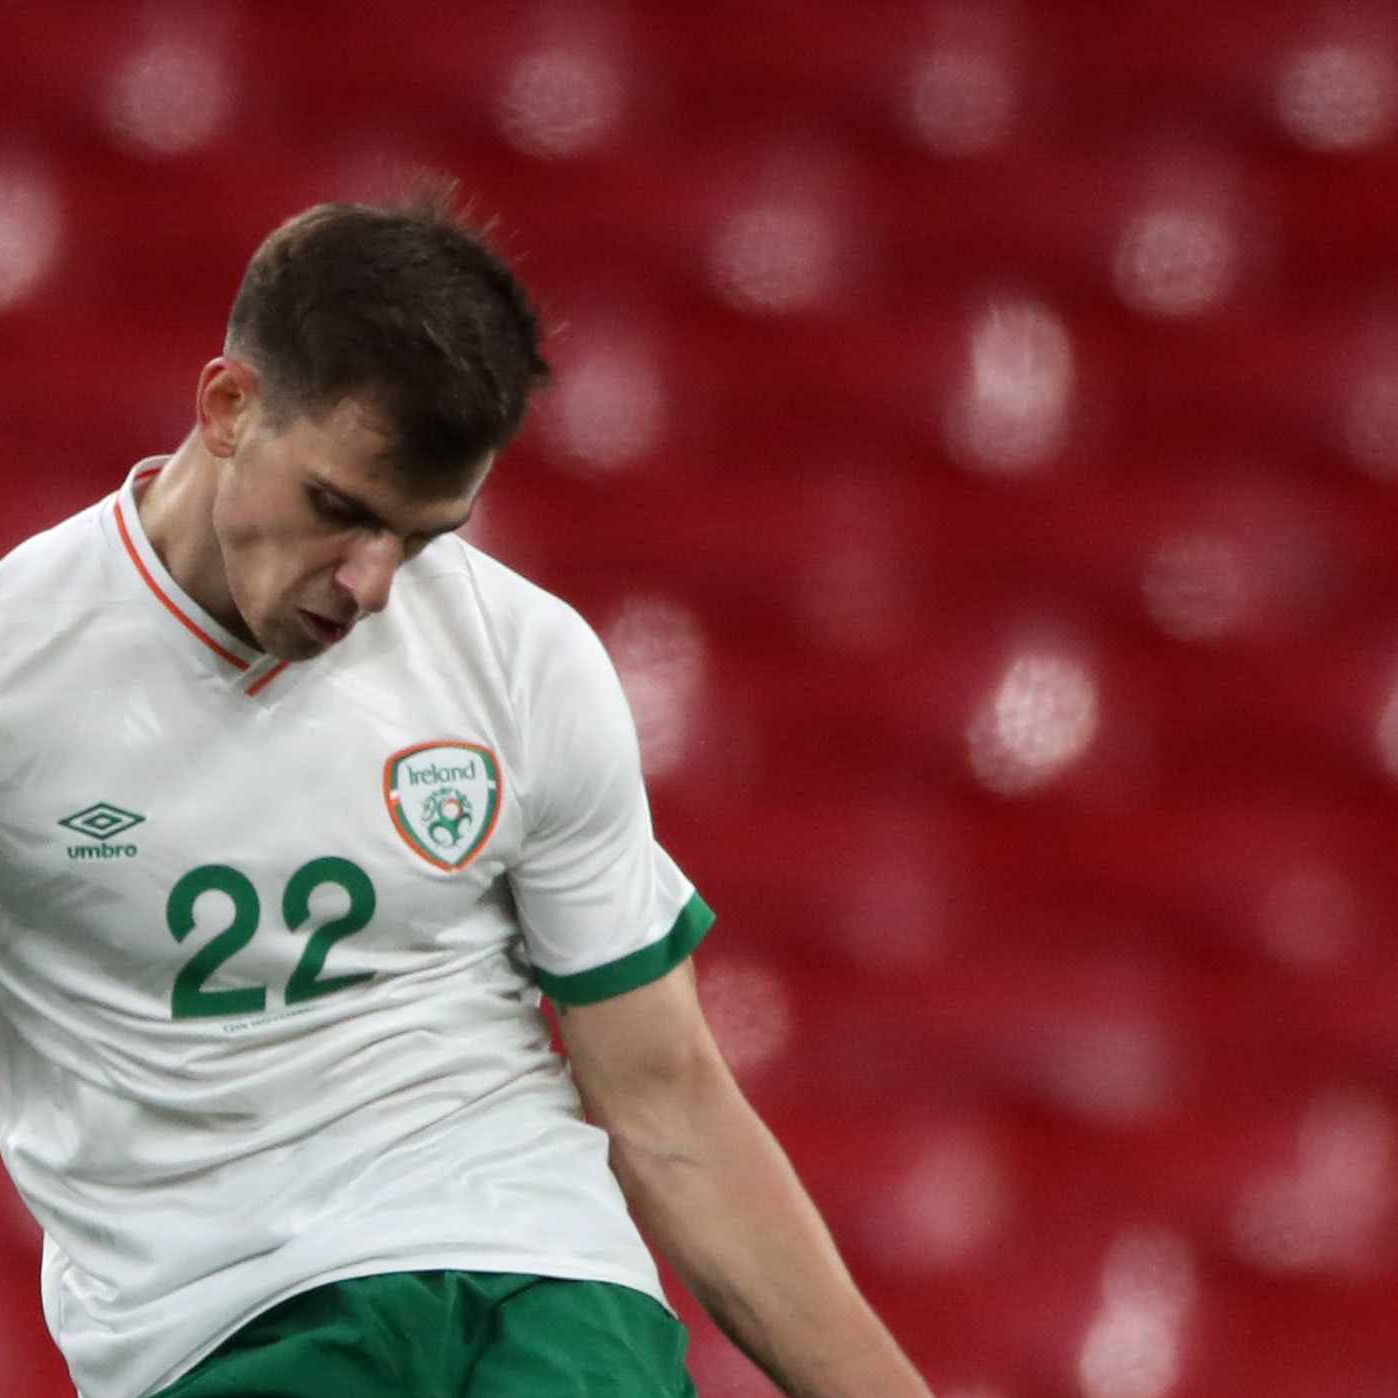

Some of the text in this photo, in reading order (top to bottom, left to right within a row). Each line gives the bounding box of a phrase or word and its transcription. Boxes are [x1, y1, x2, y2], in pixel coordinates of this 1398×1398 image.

[405, 760, 476, 786] Ireland
[67, 842, 138, 859] umbro
[166, 856, 377, 1020] 22
